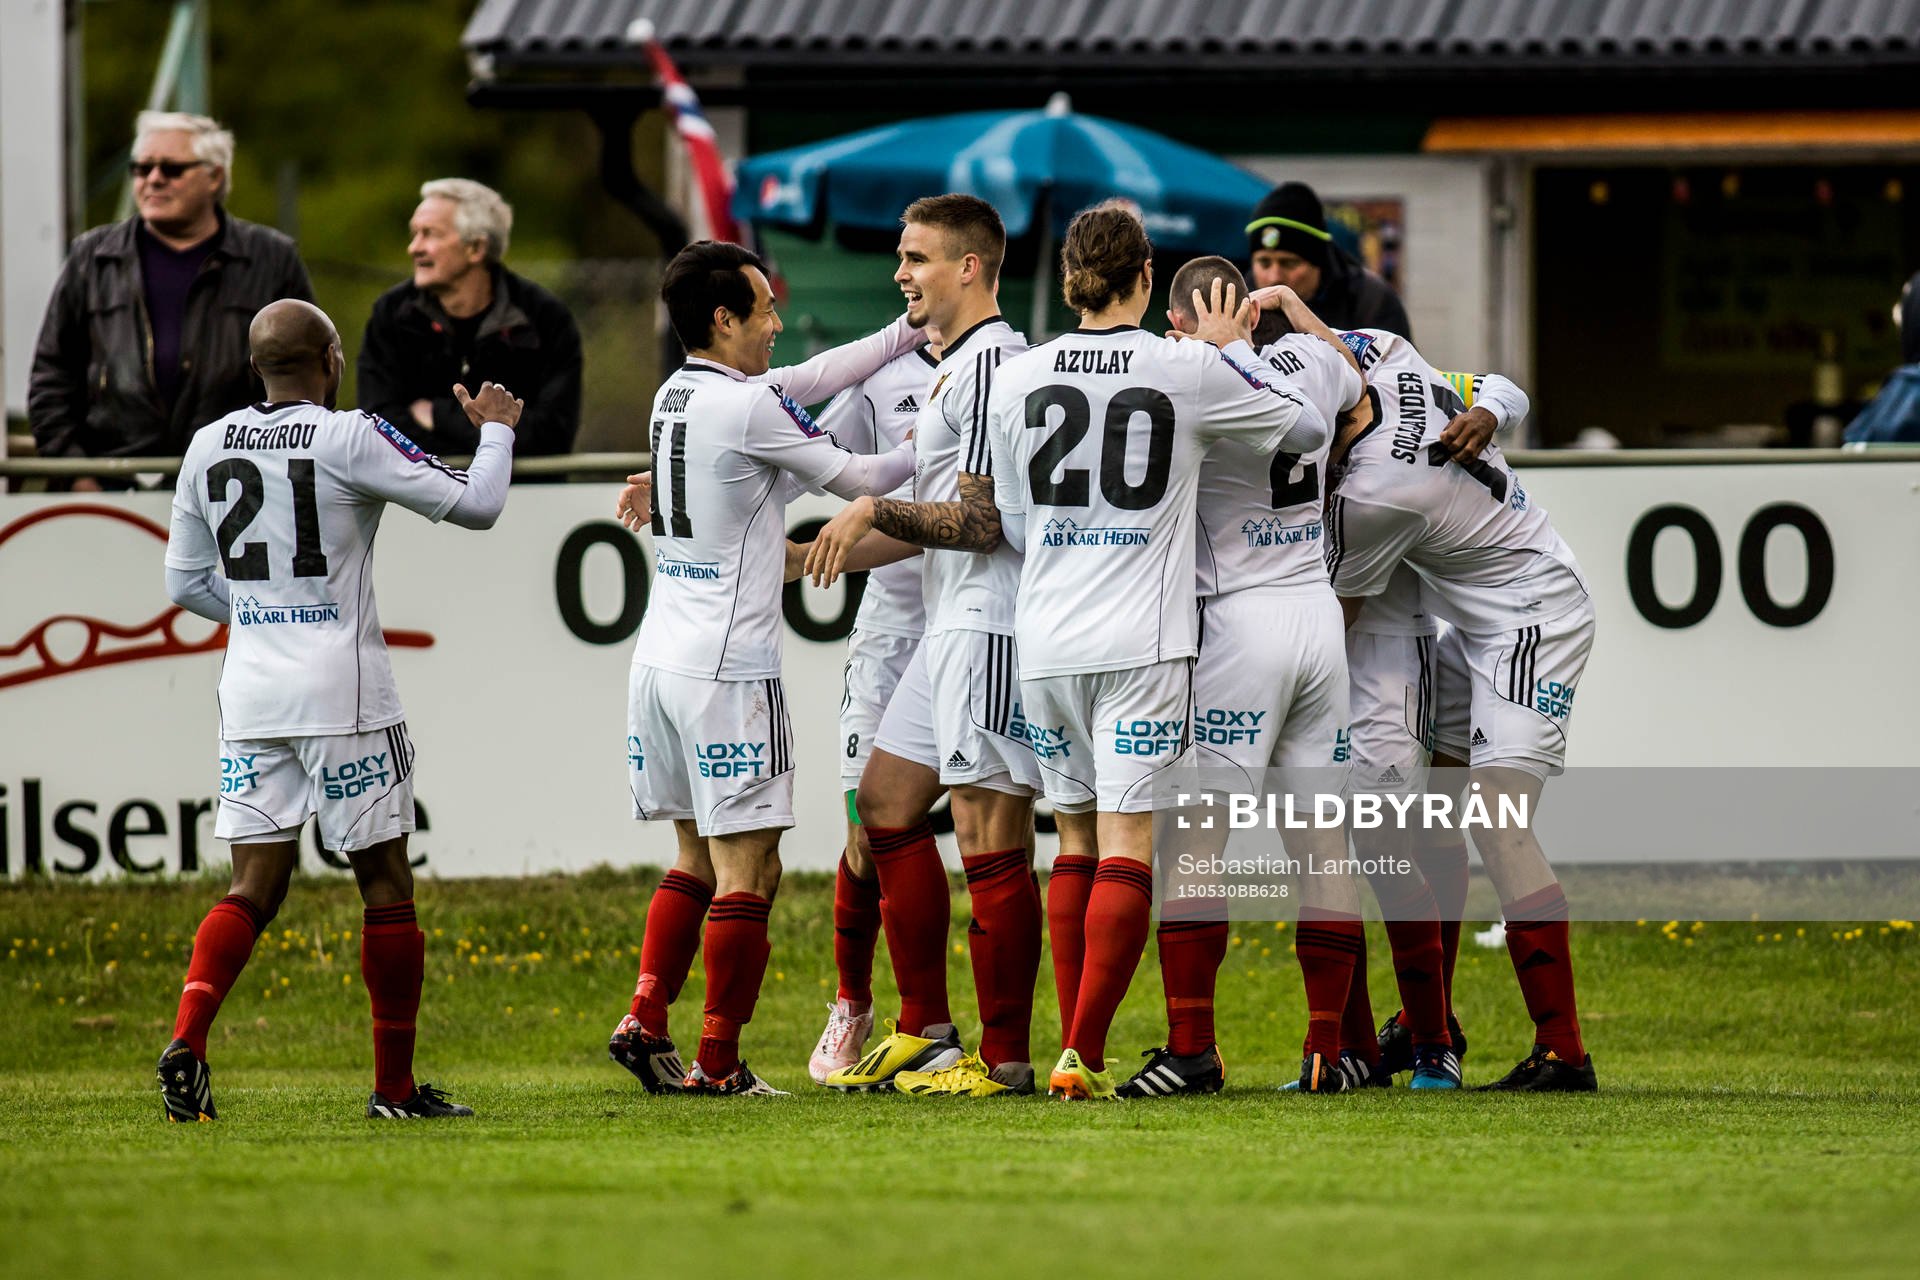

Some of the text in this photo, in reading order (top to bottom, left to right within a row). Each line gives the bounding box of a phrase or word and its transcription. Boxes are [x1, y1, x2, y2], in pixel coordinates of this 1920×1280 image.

[1054, 350, 1134, 374] AZULAY
[1391, 372, 1427, 465] SOLLANDER
[1025, 384, 1175, 510] 20
[651, 422, 693, 538] 11
[207, 458, 328, 580] 21
[1043, 531, 1150, 547] AB KARL HEDIN
[1255, 531, 1272, 547] AB
[1274, 528, 1304, 545] KARL
[684, 564, 720, 579] HEDIN
[1625, 502, 1834, 629] 00
[250, 610, 288, 624] KARL
[291, 608, 339, 623] HEDIN
[1537, 694, 1570, 720] SOF
[1115, 720, 1184, 737] LOXY
[696, 742, 766, 759] LOXY
[847, 733, 859, 758] 8
[1115, 738, 1181, 755] SOFT
[322, 752, 387, 782] LOXY
[699, 761, 764, 778] SOFT
[946, 760, 971, 768] adidas
[325, 771, 389, 800] SOFT
